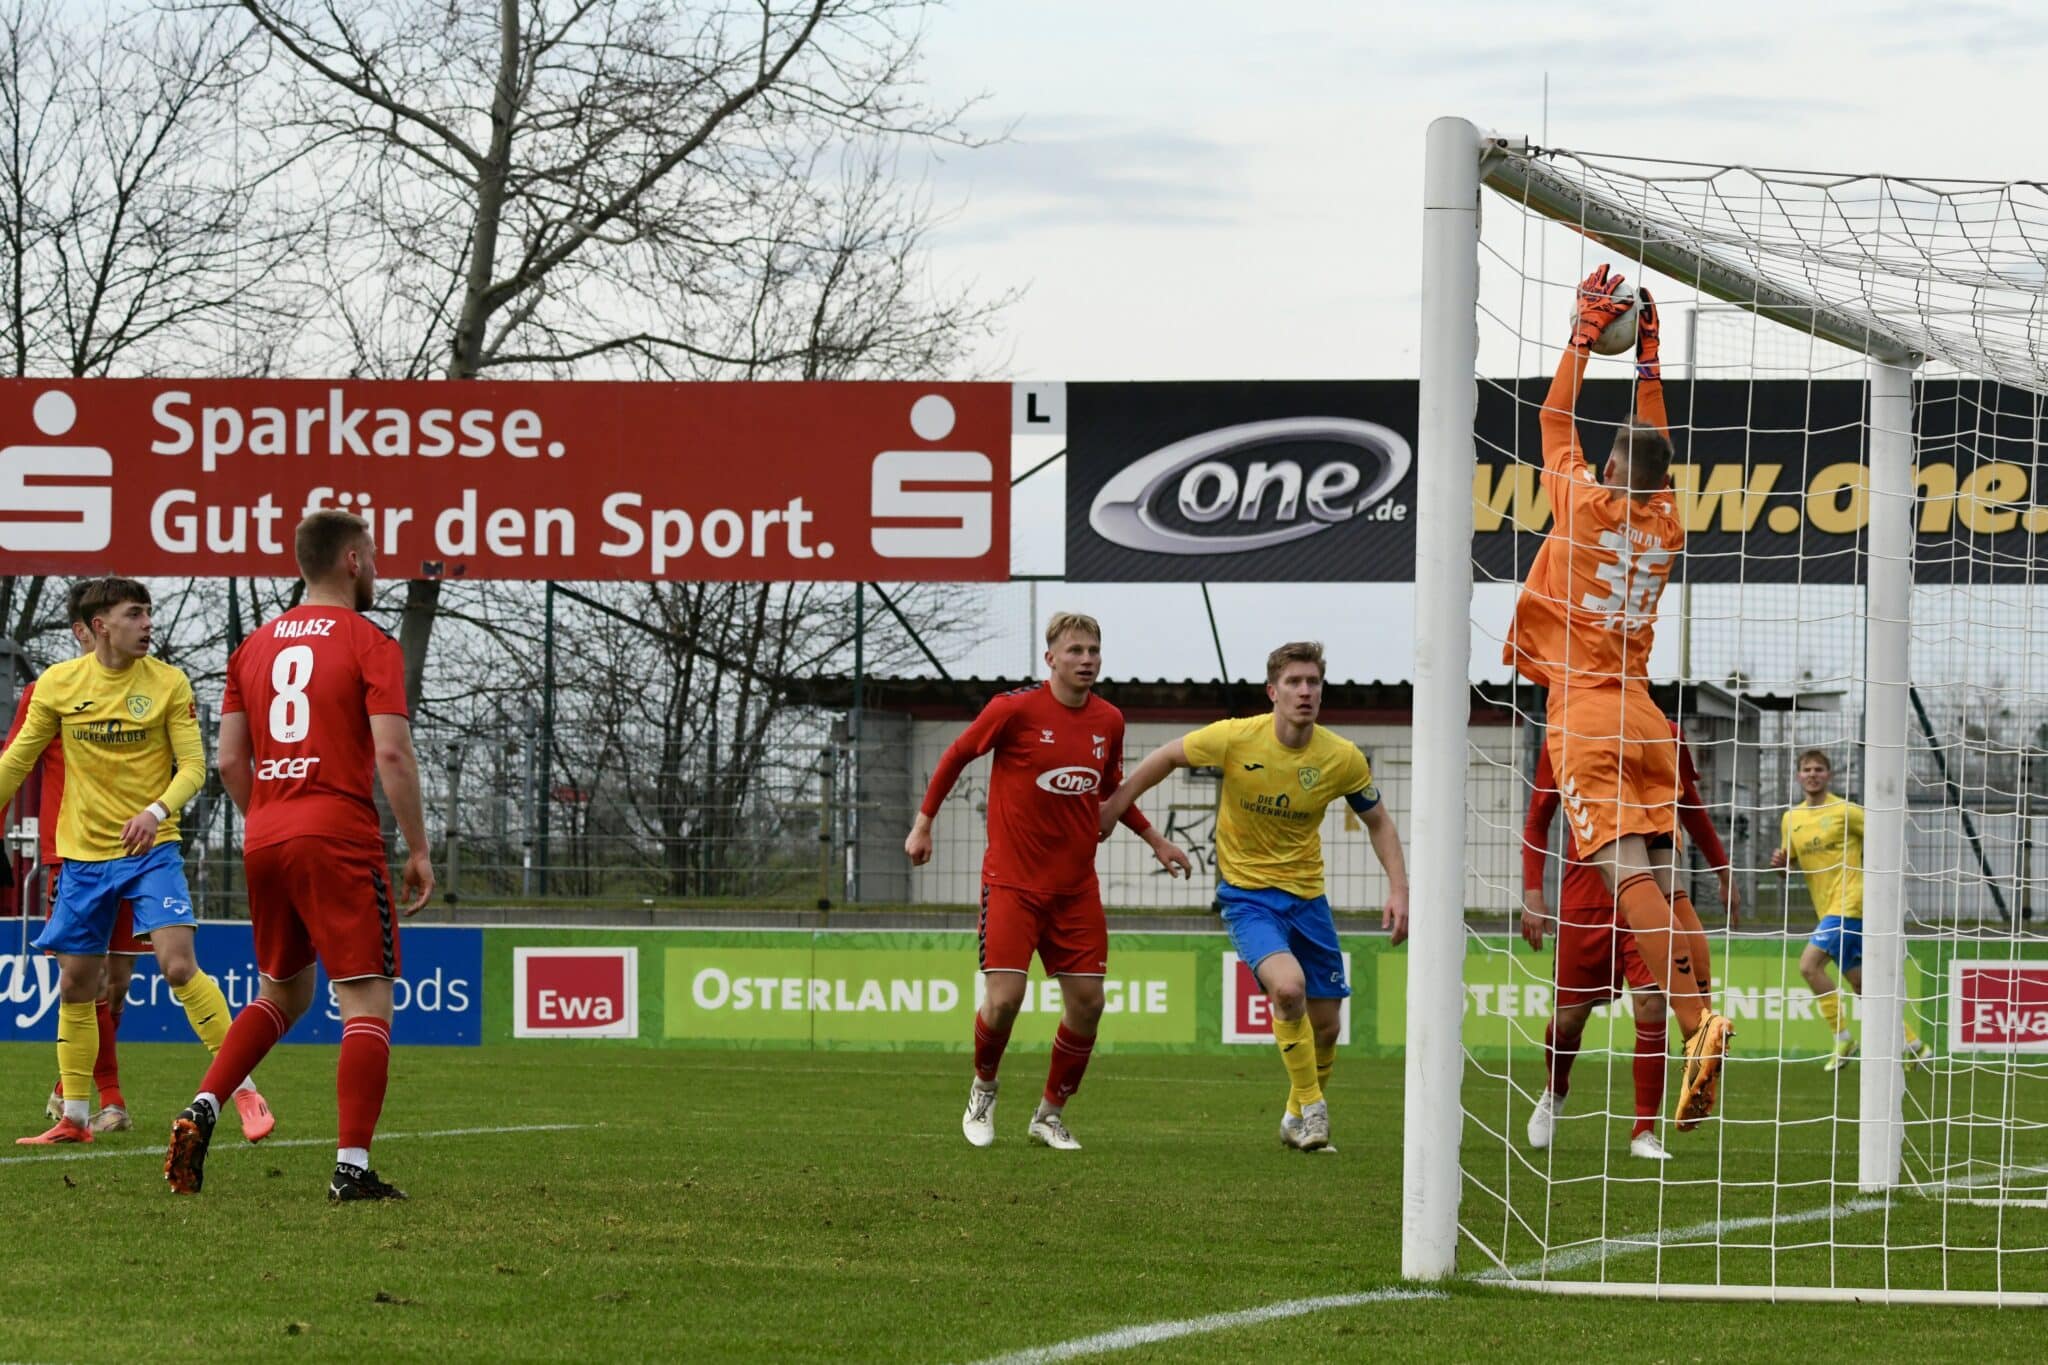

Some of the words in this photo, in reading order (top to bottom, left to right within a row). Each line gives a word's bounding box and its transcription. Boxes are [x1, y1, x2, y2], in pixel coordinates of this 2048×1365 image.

[1027, 393, 1050, 423] L
[151, 388, 565, 472] Sparkasse.
[150, 489, 283, 554] Gut
[436, 489, 575, 557] den
[600, 492, 834, 574] Sport.
[1581, 529, 1671, 617] 36
[273, 618, 336, 638] HALASZ
[269, 645, 314, 743] 8
[258, 756, 320, 781] acer
[538, 989, 614, 1020] Ewa
[692, 968, 958, 1013] OSTERLAND
[1975, 1003, 2048, 1035] Ewa
